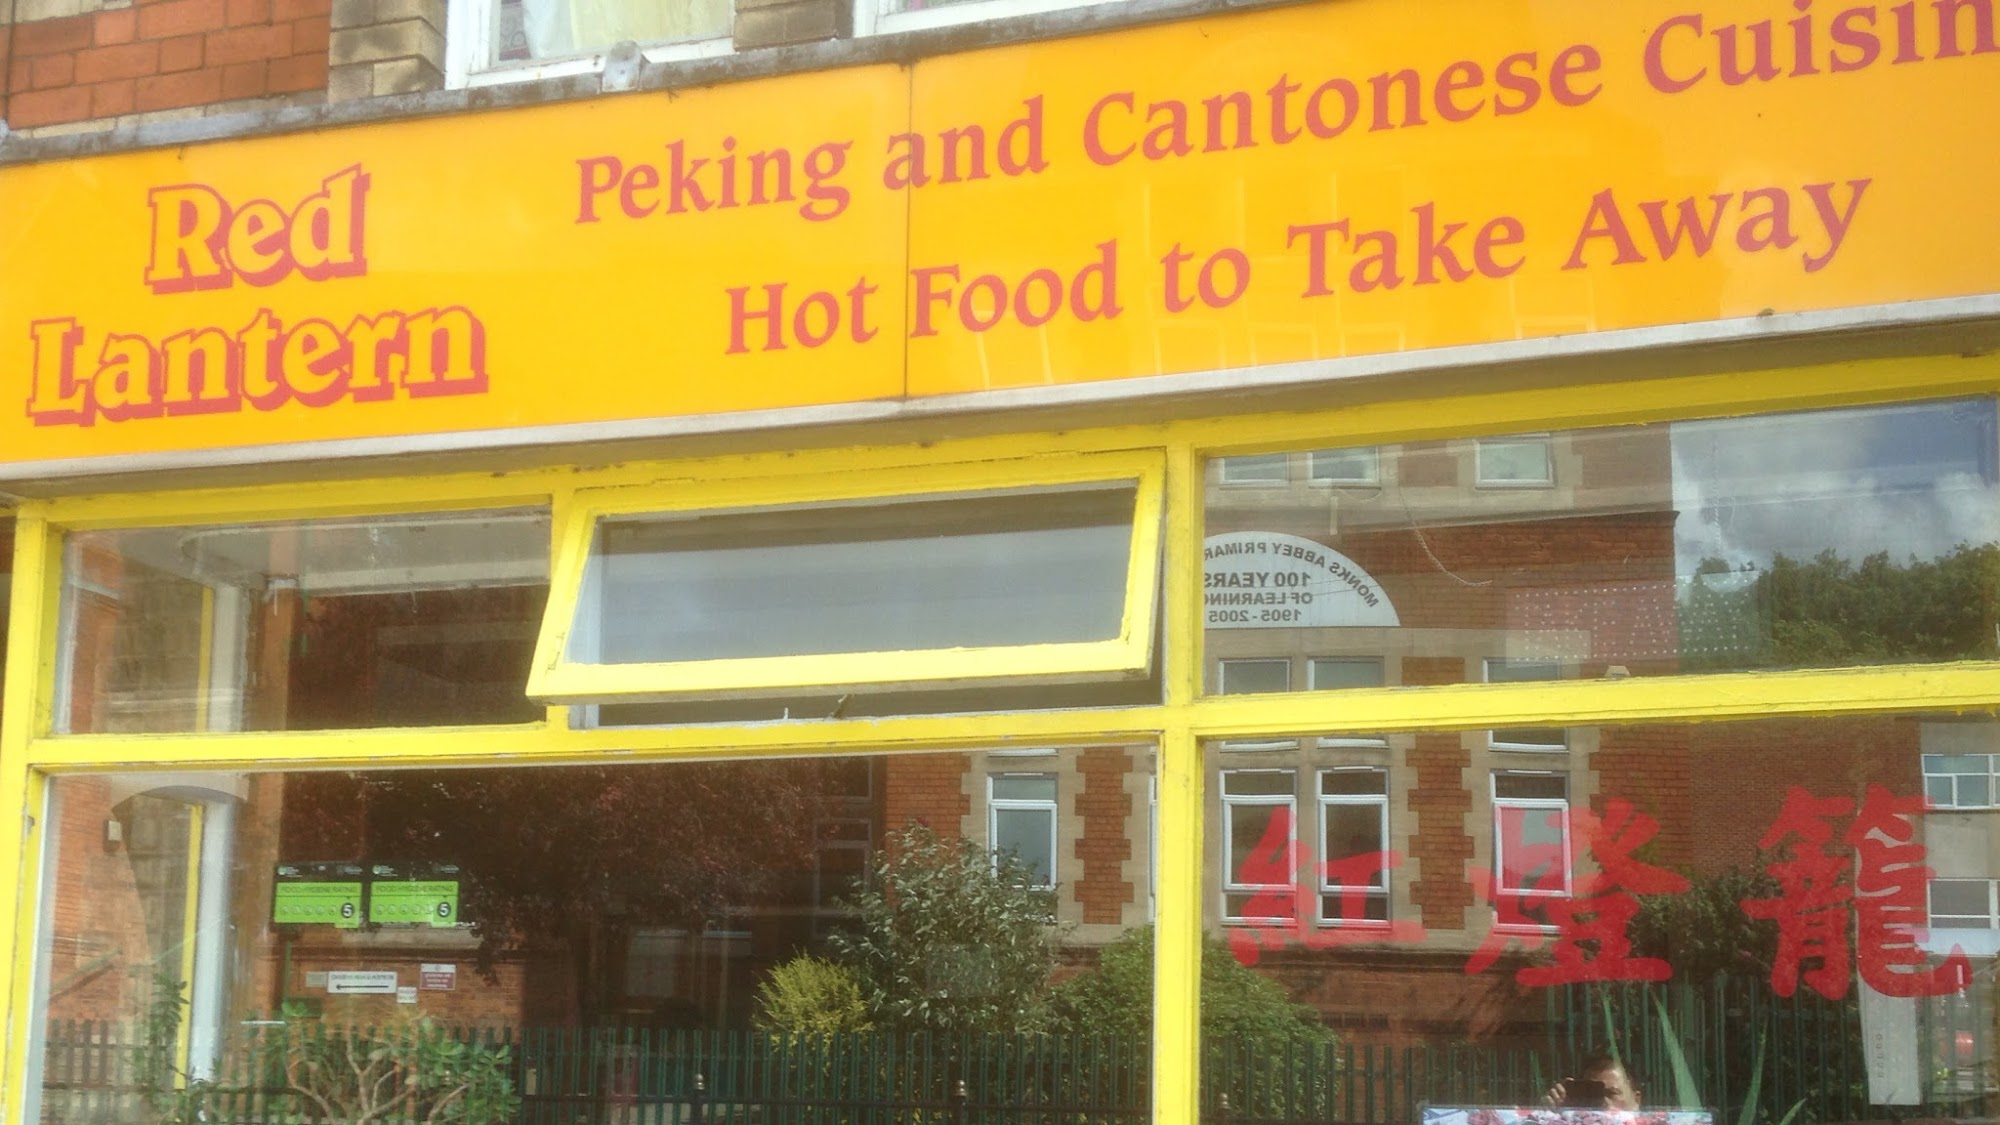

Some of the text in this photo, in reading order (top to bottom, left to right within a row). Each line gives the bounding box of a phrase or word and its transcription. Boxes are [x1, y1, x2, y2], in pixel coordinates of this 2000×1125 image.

[577, 0, 2000, 223] Peking and Cantonese Cuisin
[144, 162, 371, 295] Red
[727, 178, 1872, 355] Hot Food to Take Away
[26, 304, 490, 429] Lantern
